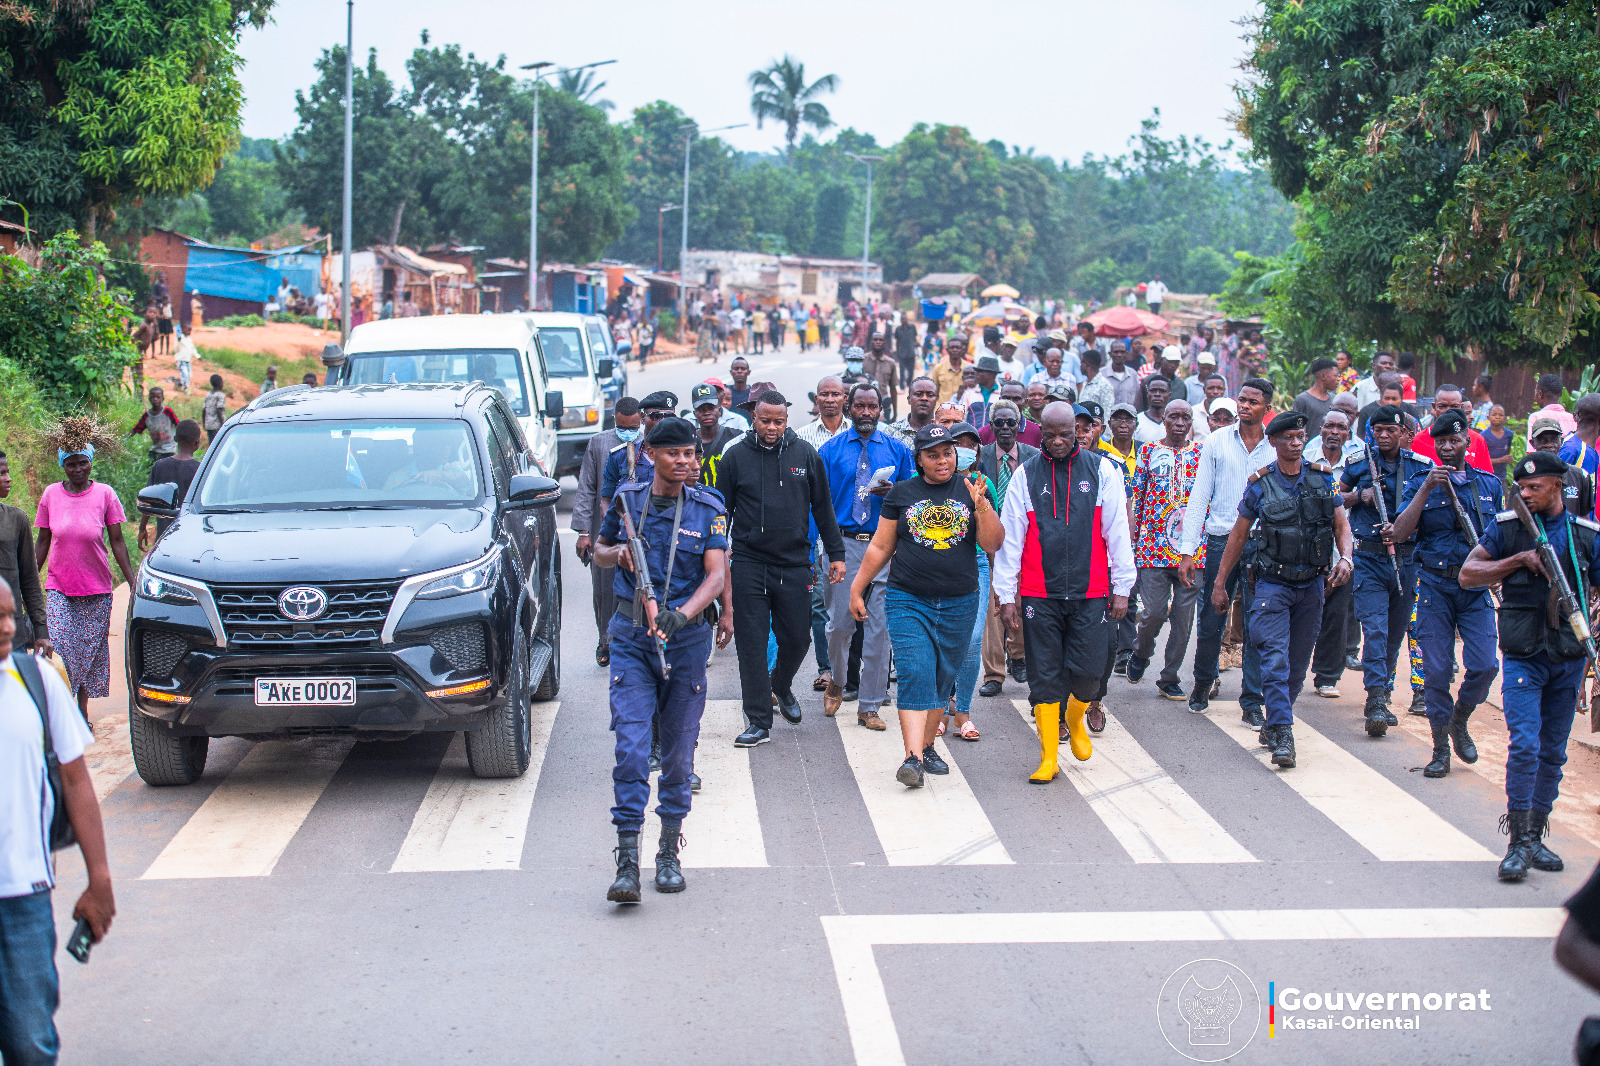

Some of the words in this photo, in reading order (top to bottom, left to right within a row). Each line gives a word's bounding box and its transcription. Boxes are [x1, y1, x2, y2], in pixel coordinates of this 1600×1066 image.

[678, 528, 701, 538] POLICE
[267, 682, 301, 701] AKE
[304, 682, 352, 701] 0002
